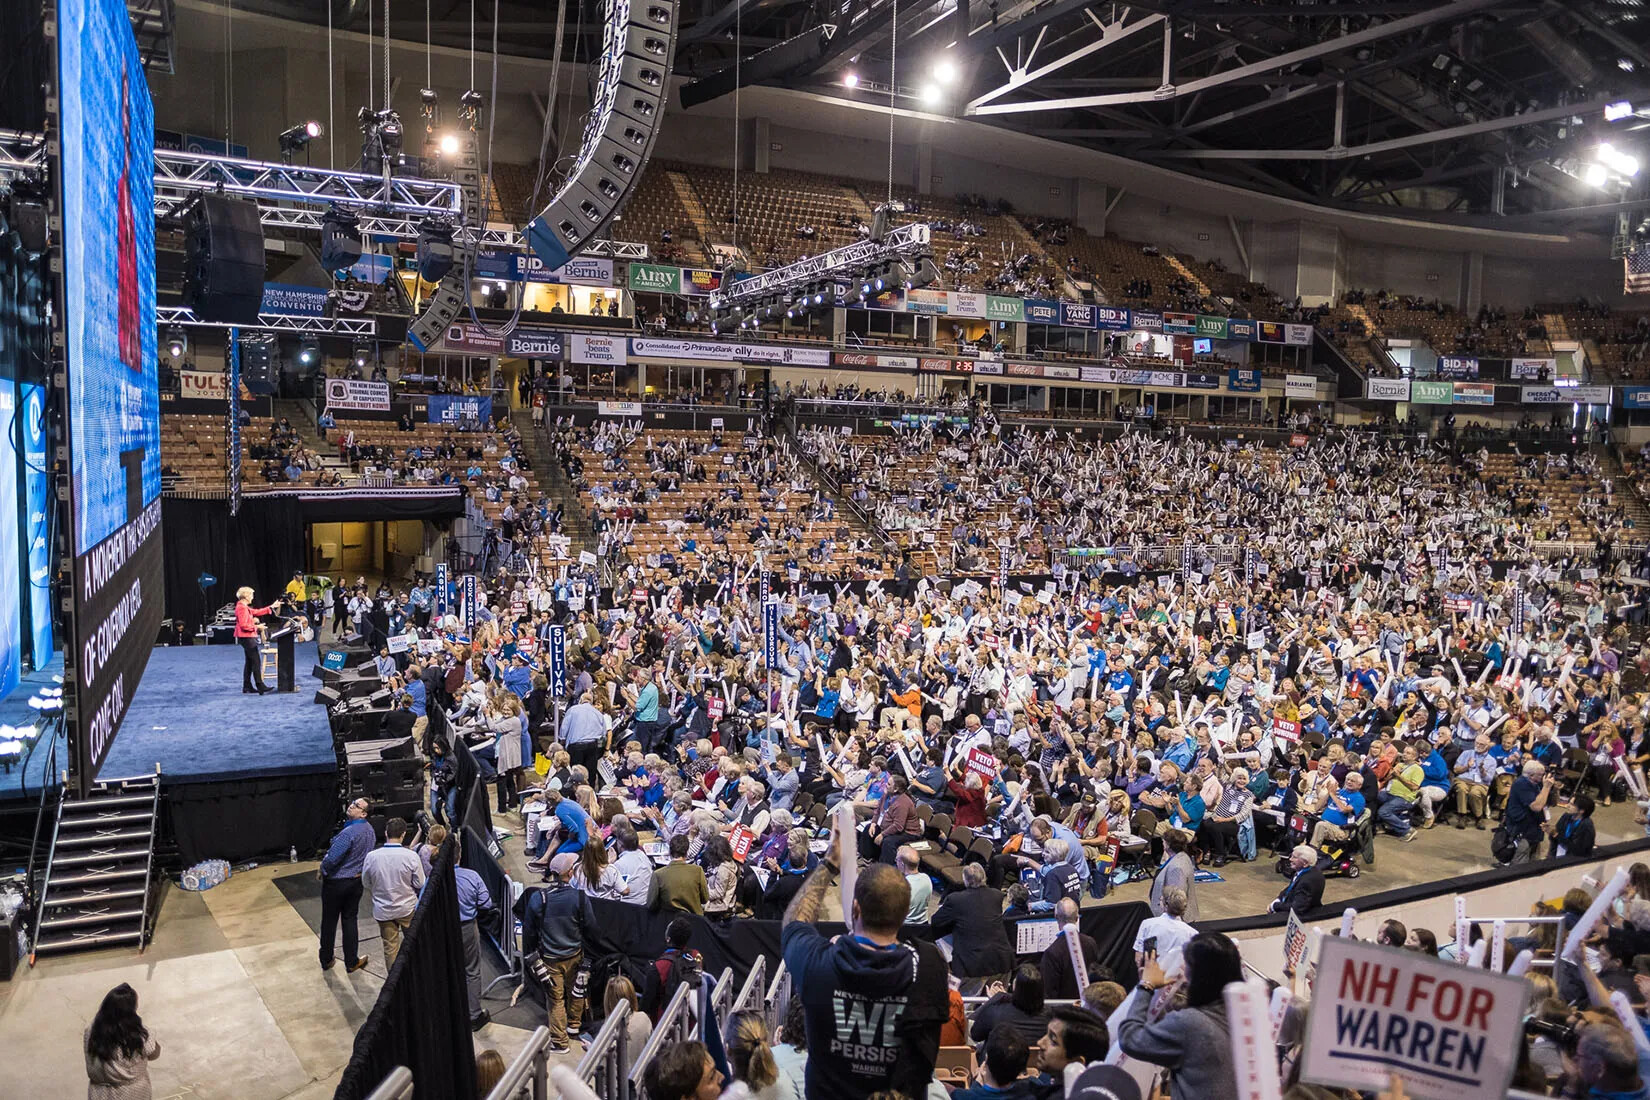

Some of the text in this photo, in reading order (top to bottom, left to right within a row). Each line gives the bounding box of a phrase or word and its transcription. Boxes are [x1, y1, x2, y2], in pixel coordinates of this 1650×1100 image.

[517, 256, 543, 270] BID
[564, 264, 609, 280] Bernie
[635, 268, 676, 284] Amy
[286, 292, 328, 300] HAMPSHIRE
[266, 300, 323, 312] CONVENTIO
[990, 300, 1020, 316] Amy
[1034, 308, 1050, 316] PETE
[1066, 304, 1090, 312] ANDREW
[1066, 310, 1090, 319] YANG
[1100, 309, 1127, 320] BIDEN
[1134, 316, 1162, 327] Bernie
[1200, 319, 1224, 332] Amy
[511, 340, 560, 354] Bernie
[585, 338, 613, 346] Bernie
[645, 342, 680, 350] Consolidated
[584, 351, 614, 360] Trump.
[588, 345, 610, 353] beats
[691, 344, 733, 354] PrimaryBank
[735, 346, 752, 356] ally
[1443, 359, 1474, 368] BIDEN
[1516, 365, 1554, 374] Bere
[182, 375, 227, 390] TULS
[1372, 385, 1406, 395] Bernie
[1416, 385, 1448, 400] Amy
[84, 555, 92, 602] A
[92, 527, 126, 594] MOVEMENT
[85, 593, 130, 688] OF GOVERNOR
[328, 652, 342, 662] 00:00
[554, 628, 564, 695] SULLIVAN
[90, 672, 124, 766] COME ON!
[709, 708, 723, 717] SUNU
[1278, 720, 1294, 731] VETO
[1274, 727, 1298, 740] SUNUNU
[974, 752, 993, 766] VETO
[968, 760, 995, 777] SUNUNU
[730, 825, 743, 850] SUNU
[736, 836, 750, 857] VETO
[1107, 844, 1117, 858] VET
[1338, 958, 1496, 1031] NH FOR
[833, 998, 906, 1046] WE
[1336, 1004, 1487, 1074] WARREN
[830, 1038, 897, 1062] PERSIS
[851, 1062, 886, 1073] WARREN
